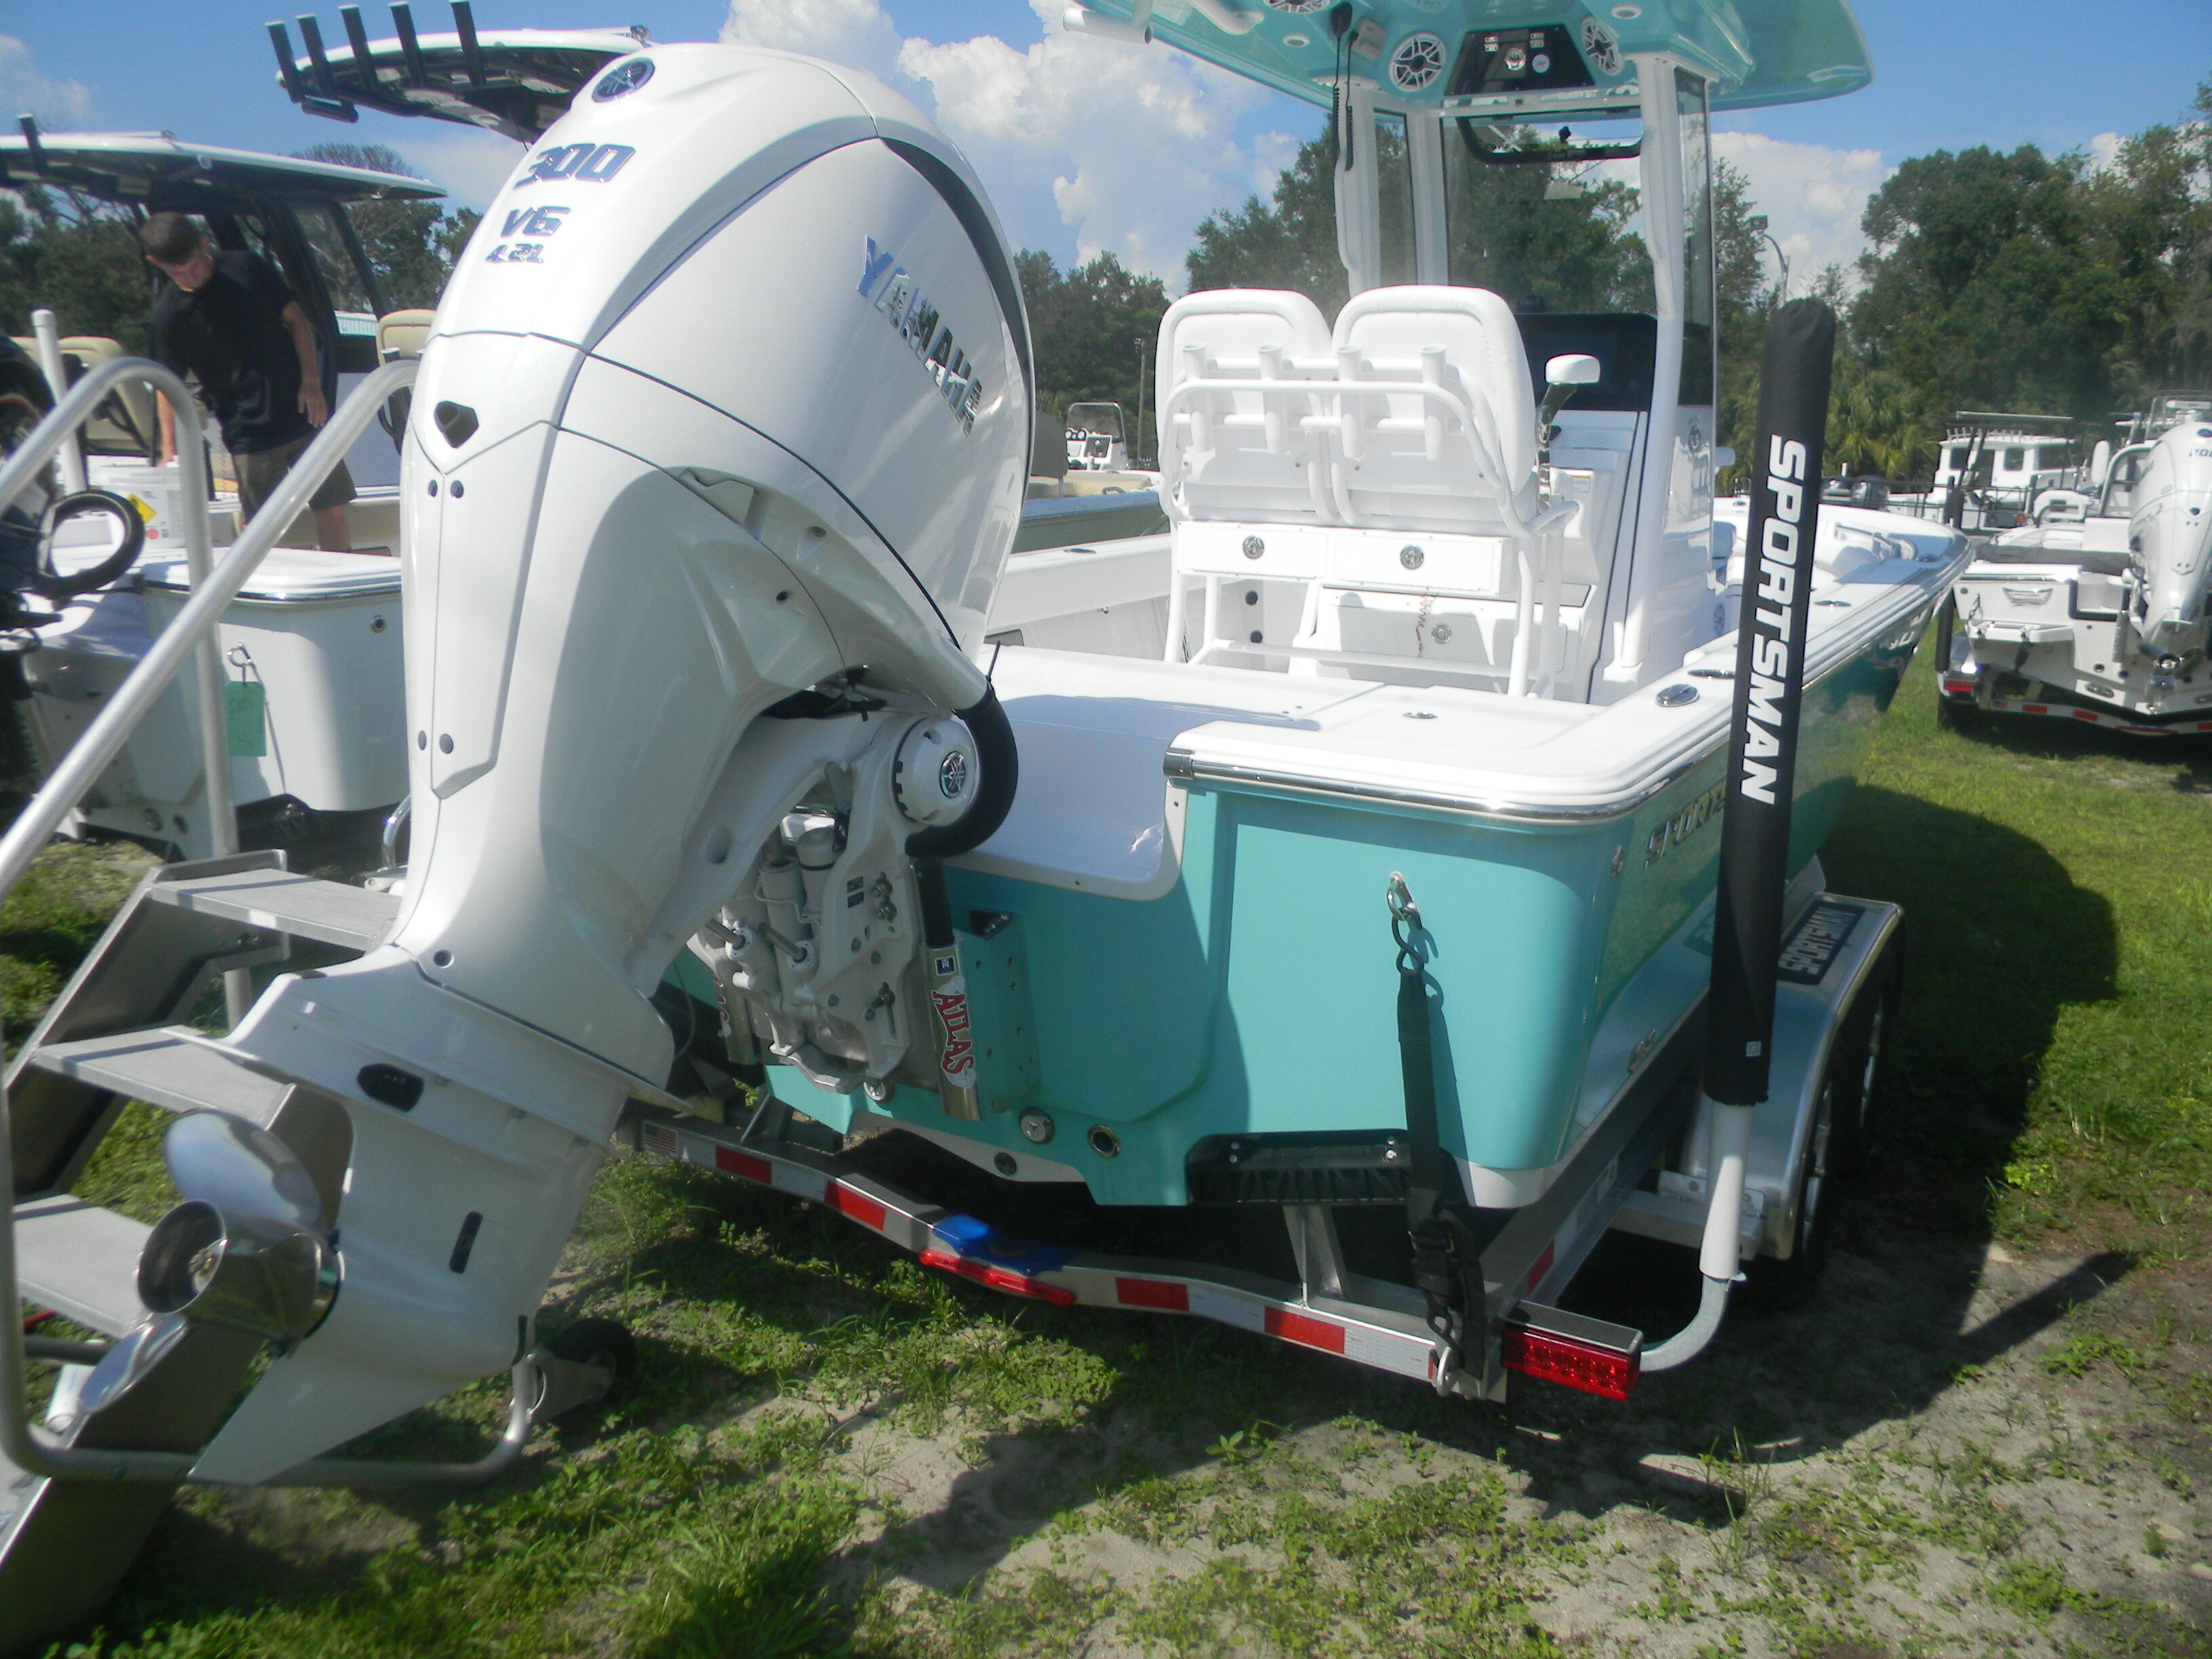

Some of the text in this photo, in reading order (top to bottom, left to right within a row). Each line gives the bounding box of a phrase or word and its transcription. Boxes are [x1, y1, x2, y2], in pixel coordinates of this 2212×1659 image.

[513, 142, 636, 190] 300
[500, 205, 571, 238] V6
[857, 234, 983, 437] YAMAHA
[1740, 434, 1807, 805] SPORTSMAN
[930, 989, 975, 1074] ATLAS
